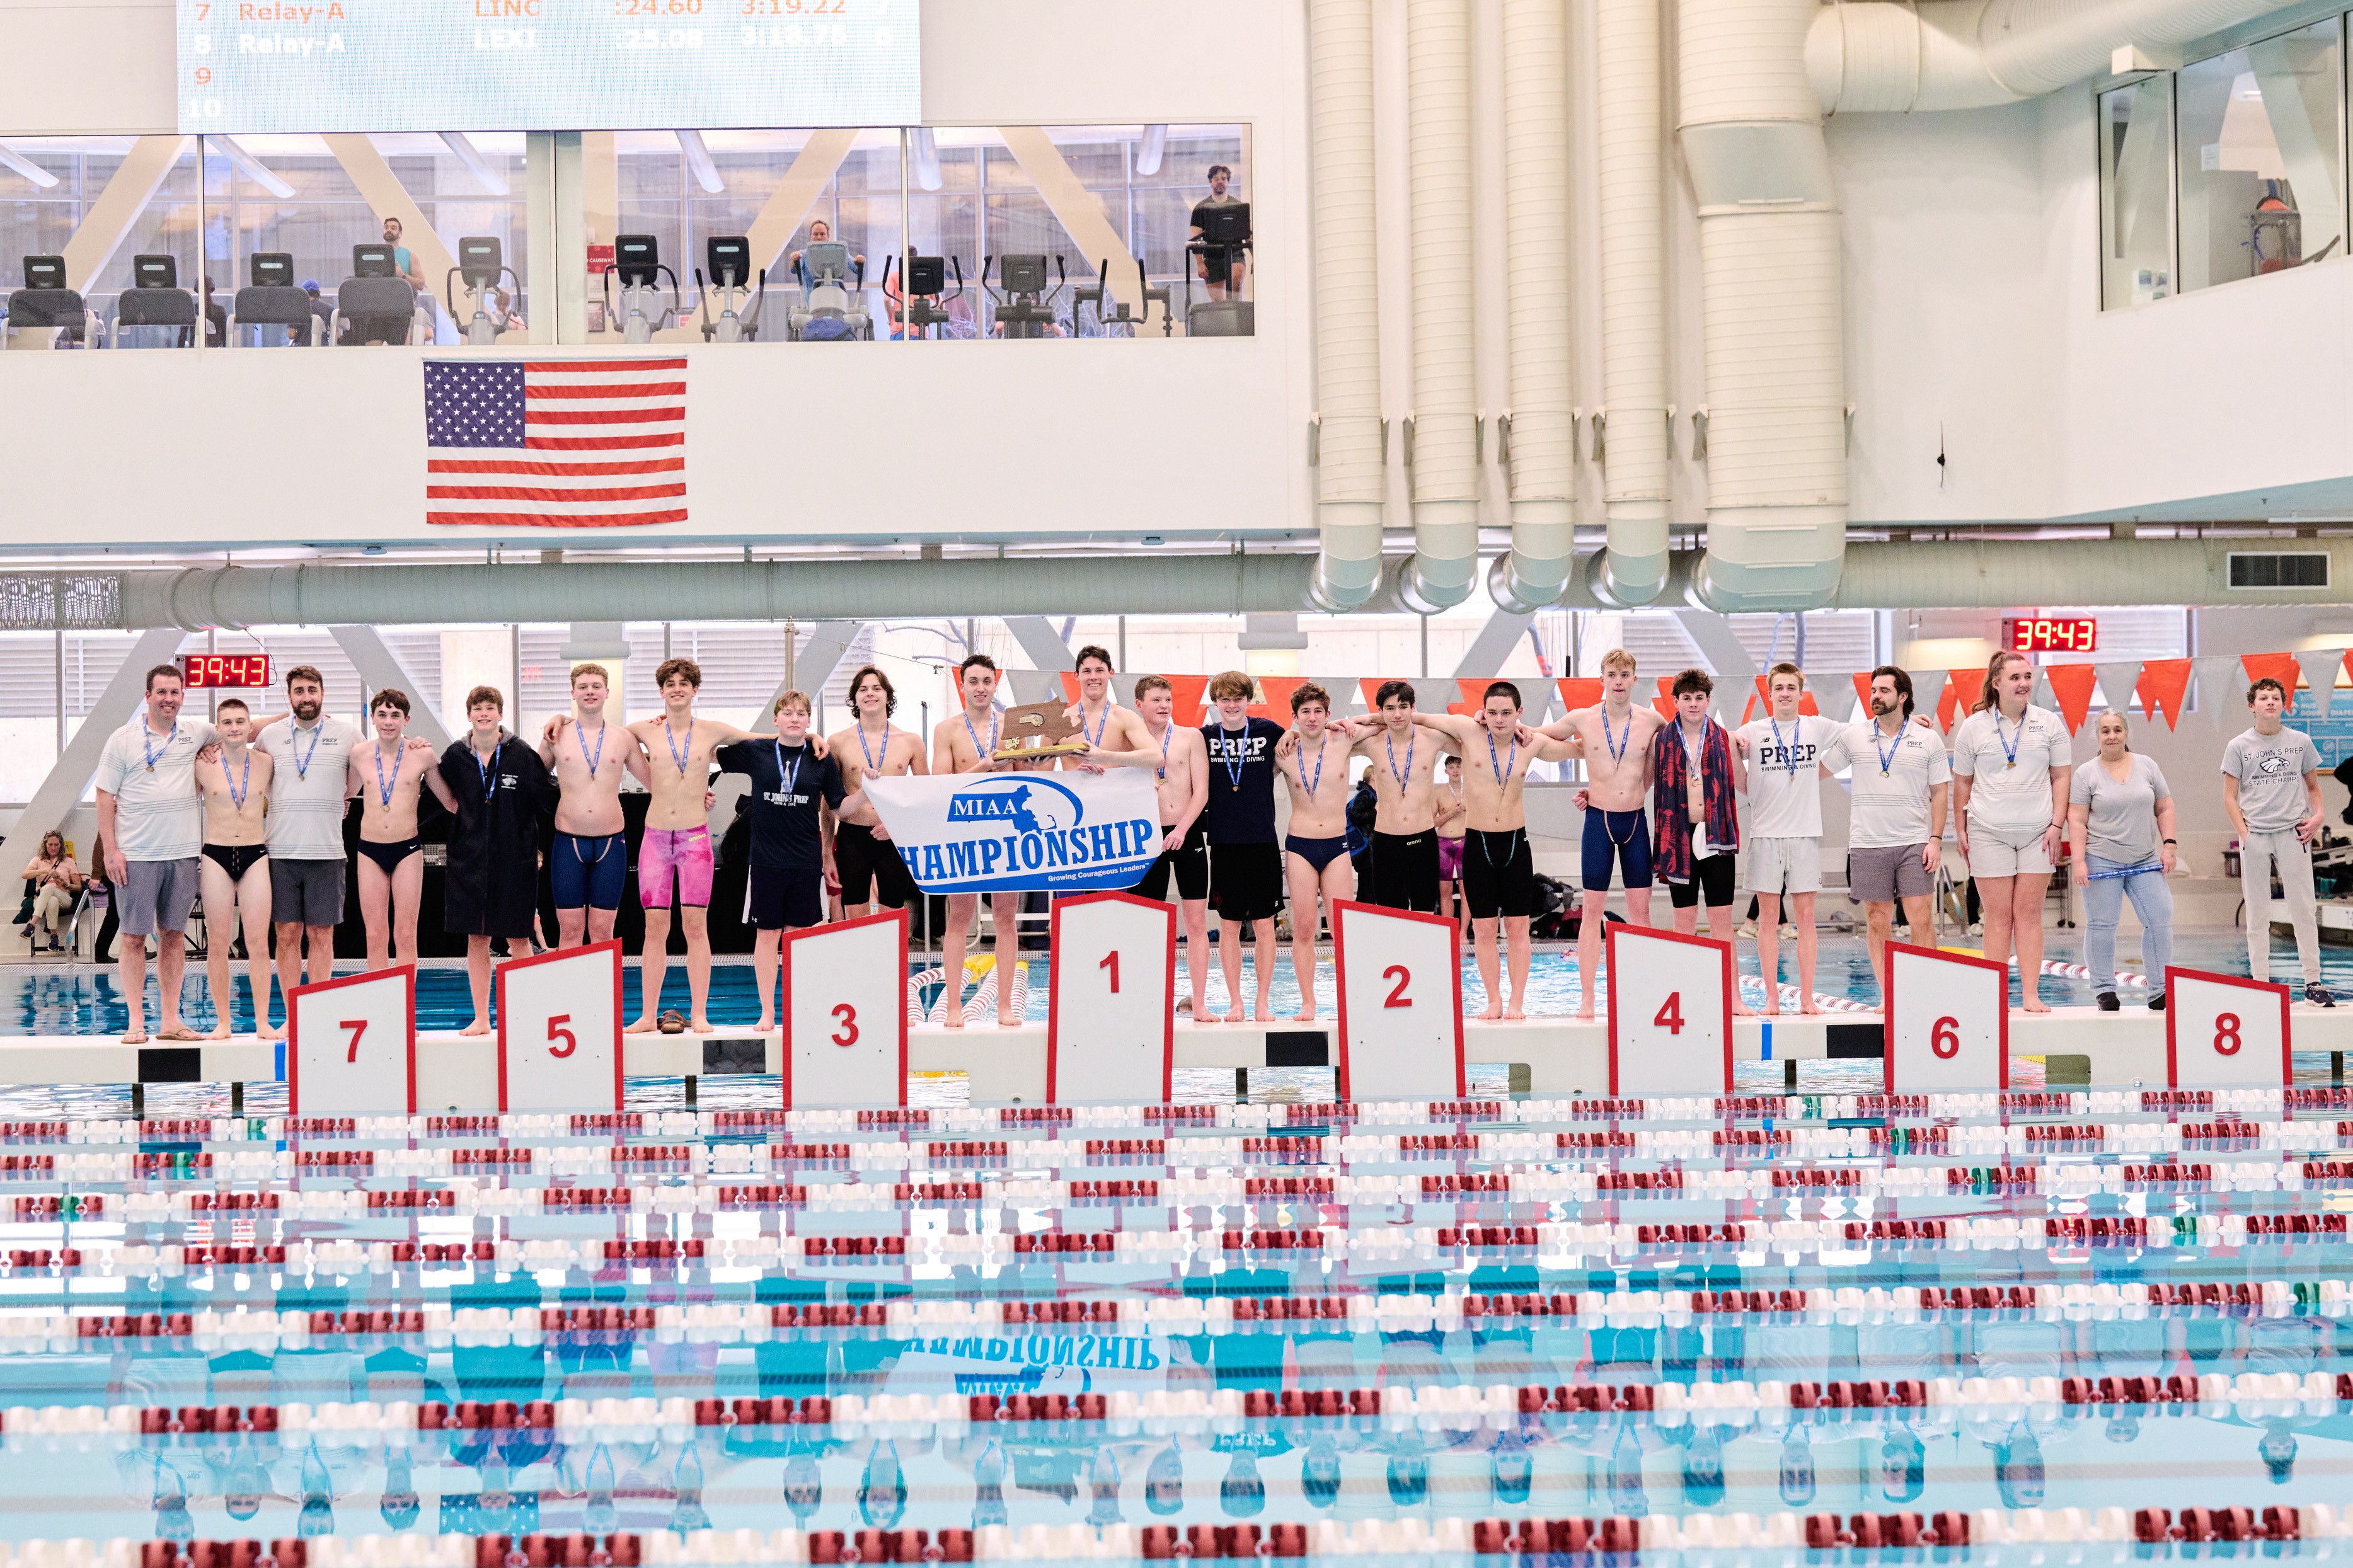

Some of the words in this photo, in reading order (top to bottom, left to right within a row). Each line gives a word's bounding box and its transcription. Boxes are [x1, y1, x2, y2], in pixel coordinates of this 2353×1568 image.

[195, 3, 210, 21] 7
[239, 1, 345, 24] Relay-A
[475, 0, 540, 16] LINC
[616, 0, 702, 14] :24.60
[742, 0, 846, 14] 3:19.22
[194, 34, 211, 54] 8
[239, 32, 346, 57] Relay-A
[475, 28, 538, 48] LEXI
[195, 67, 211, 85] 9
[188, 98, 221, 118] 10
[2016, 621, 2093, 650] 39:43
[189, 657, 265, 685] 39:43
[1004, 737, 1020, 745] 2026
[1209, 737, 1267, 756] PREP
[2256, 748, 2282, 758] JOHN'S
[1760, 745, 1816, 765] PREP
[2272, 776, 2299, 784] CHAMPS
[771, 793, 792, 803] JOHNS
[793, 794, 809, 804] PREP
[953, 799, 1018, 816] MIAA
[688, 833, 706, 842] arena
[896, 818, 1153, 881] HAMPIONSHIP
[1048, 873, 1076, 881] Growing
[1078, 869, 1119, 878] Courageous
[1100, 950, 1119, 993] 1
[1383, 964, 1412, 1008] 2
[831, 1003, 859, 1047] 3
[1654, 992, 1685, 1034] 4
[339, 1019, 368, 1063] 7
[548, 1014, 576, 1058] 5
[1931, 1016, 1960, 1059] 6
[2214, 1012, 2241, 1056] 8
